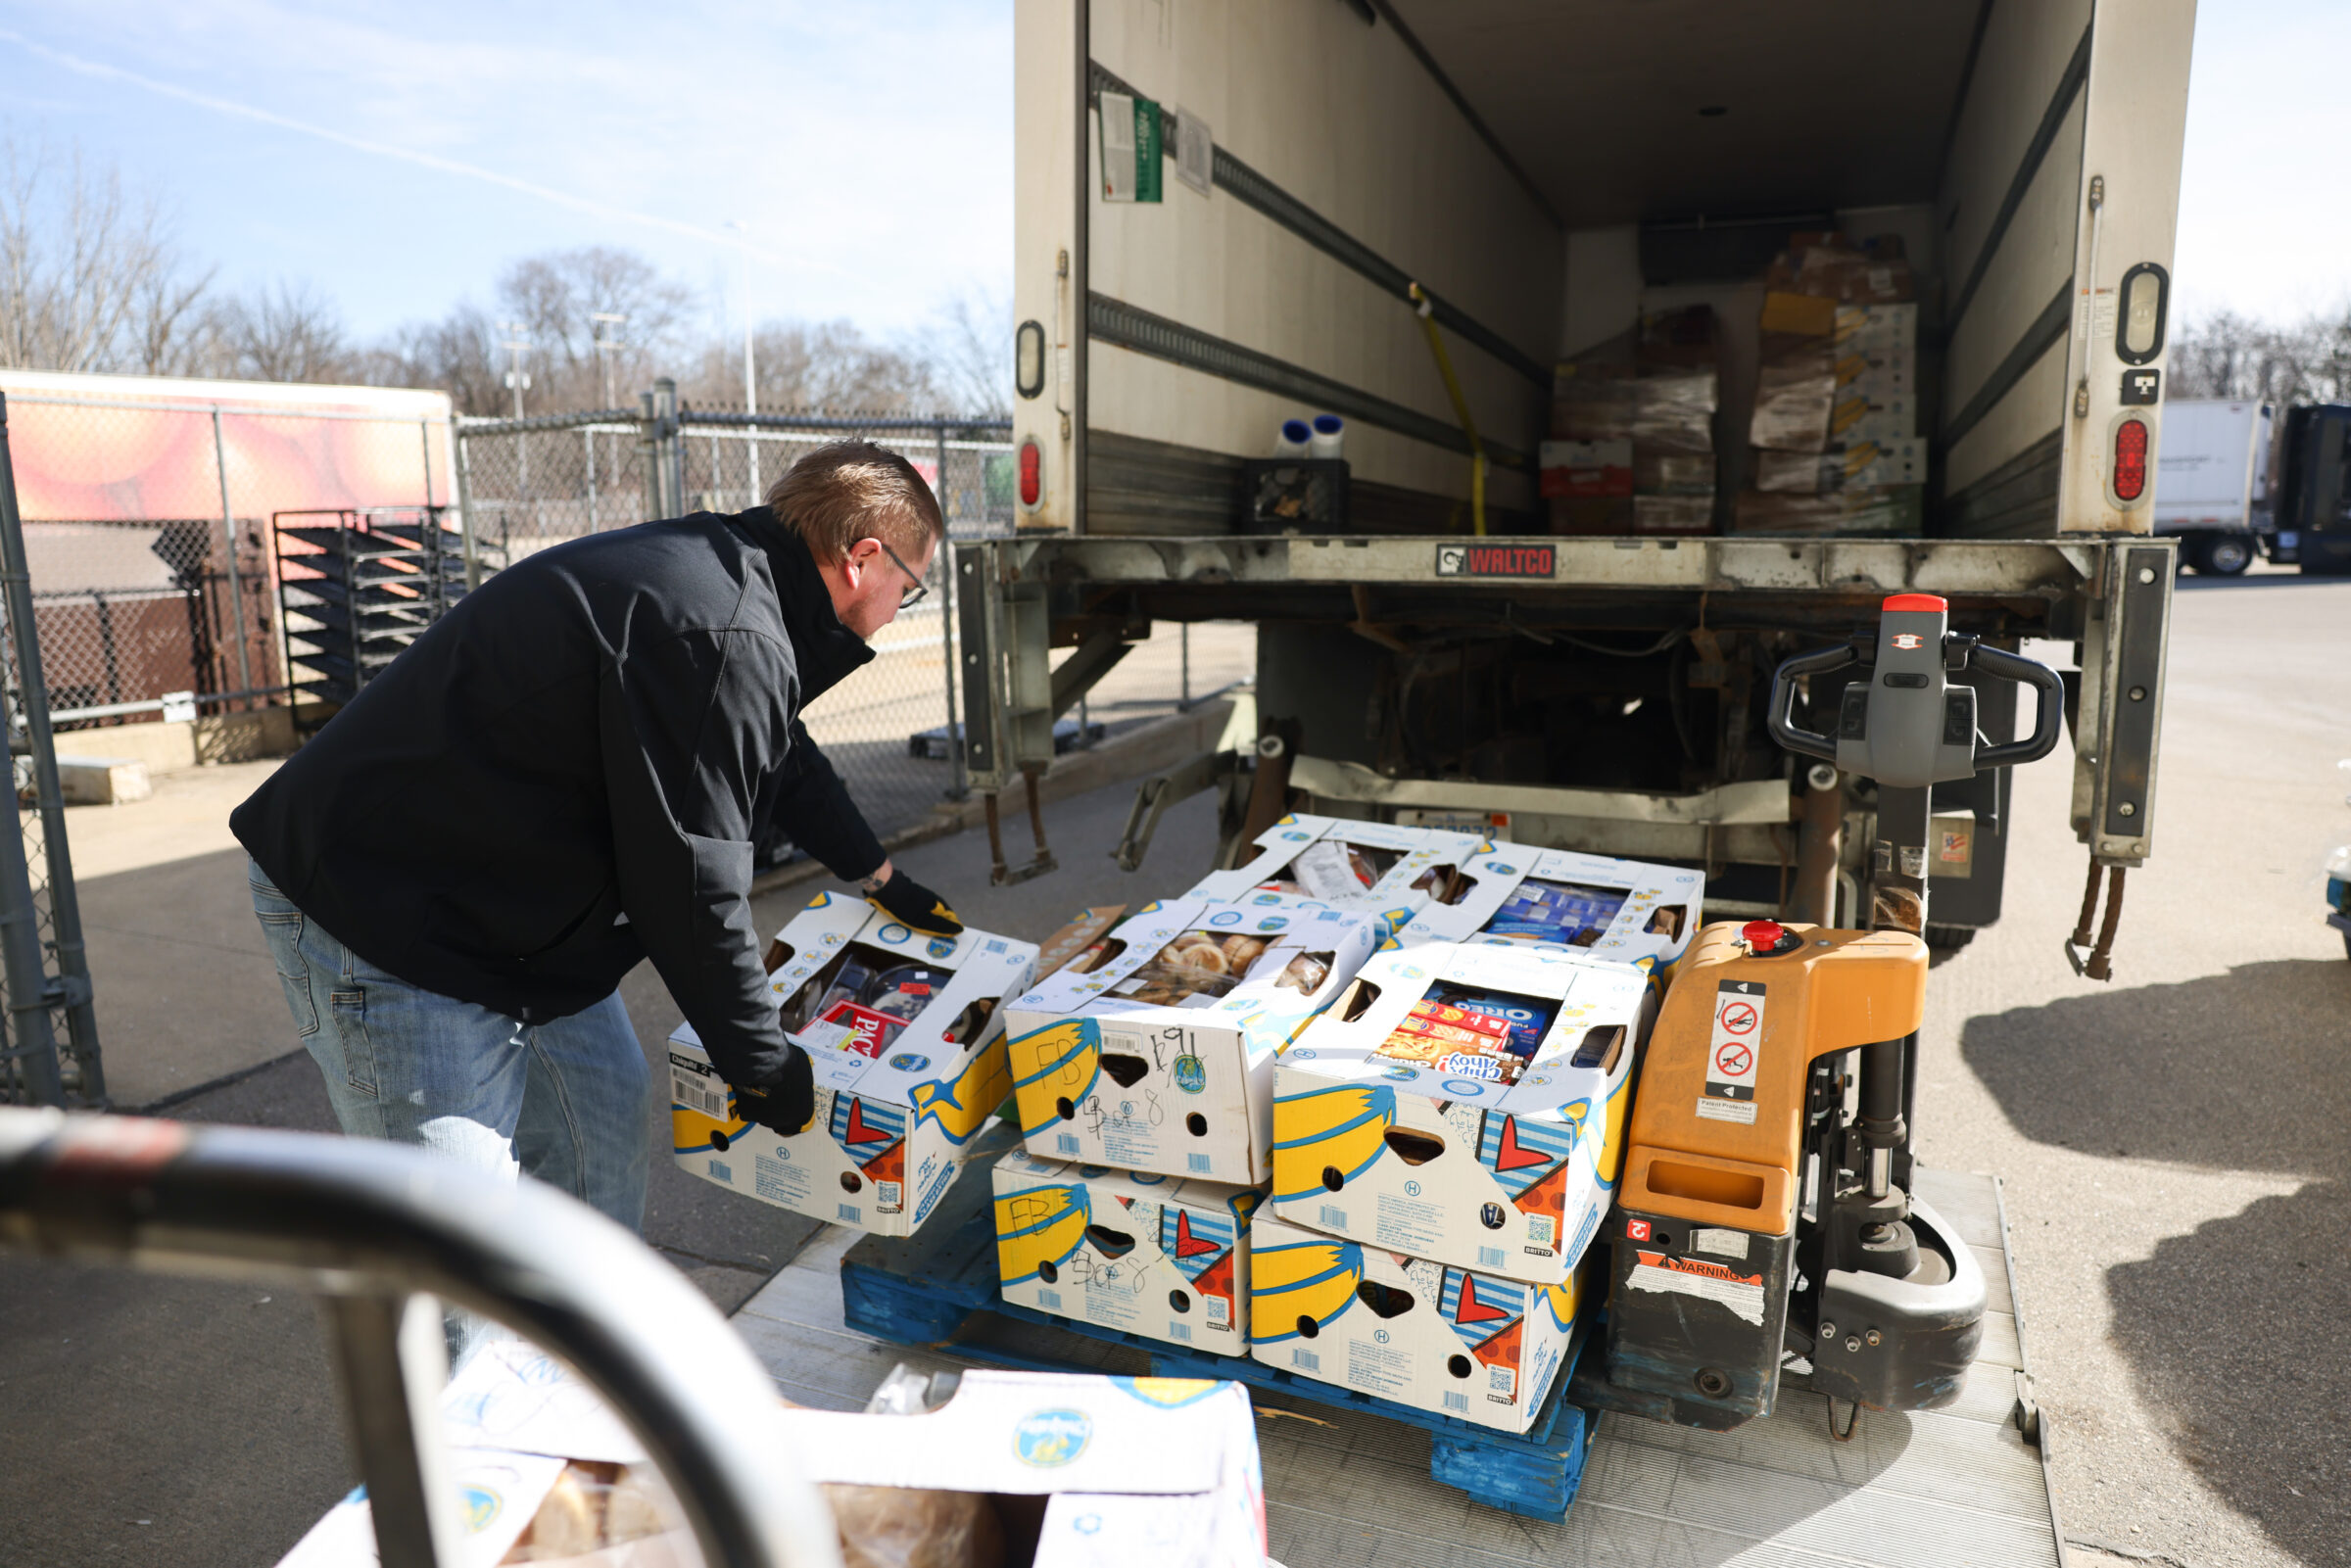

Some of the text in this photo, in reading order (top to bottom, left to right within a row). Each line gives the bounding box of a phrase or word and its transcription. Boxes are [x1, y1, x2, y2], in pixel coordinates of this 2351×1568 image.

[1468, 548, 1552, 574] WALTCO
[1455, 1002, 1533, 1021] OREO
[1036, 1038, 1081, 1089] FB
[1450, 1066, 1501, 1079] Chips
[1722, 1103, 1752, 1113] Protected
[1009, 1198, 1054, 1241] FB
[1525, 1246, 1553, 1257] BRITTO
[1674, 1260, 1740, 1280] WARNING
